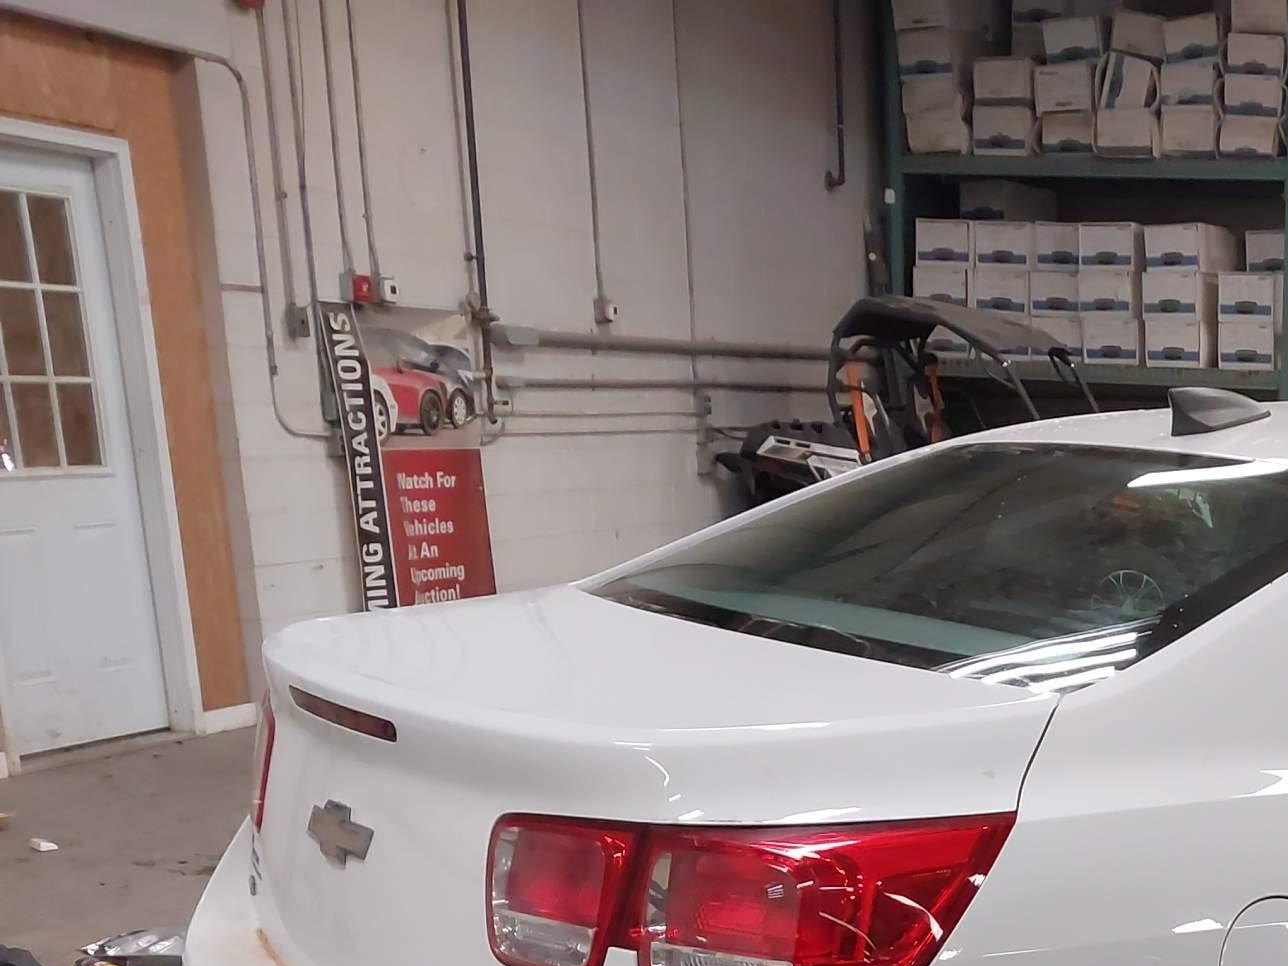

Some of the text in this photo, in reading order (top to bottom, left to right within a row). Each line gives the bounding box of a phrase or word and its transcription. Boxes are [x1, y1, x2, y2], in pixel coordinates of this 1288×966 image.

[329, 312, 380, 534] ATTRACTIONS
[436, 471, 456, 488] For
[420, 541, 439, 559] An
